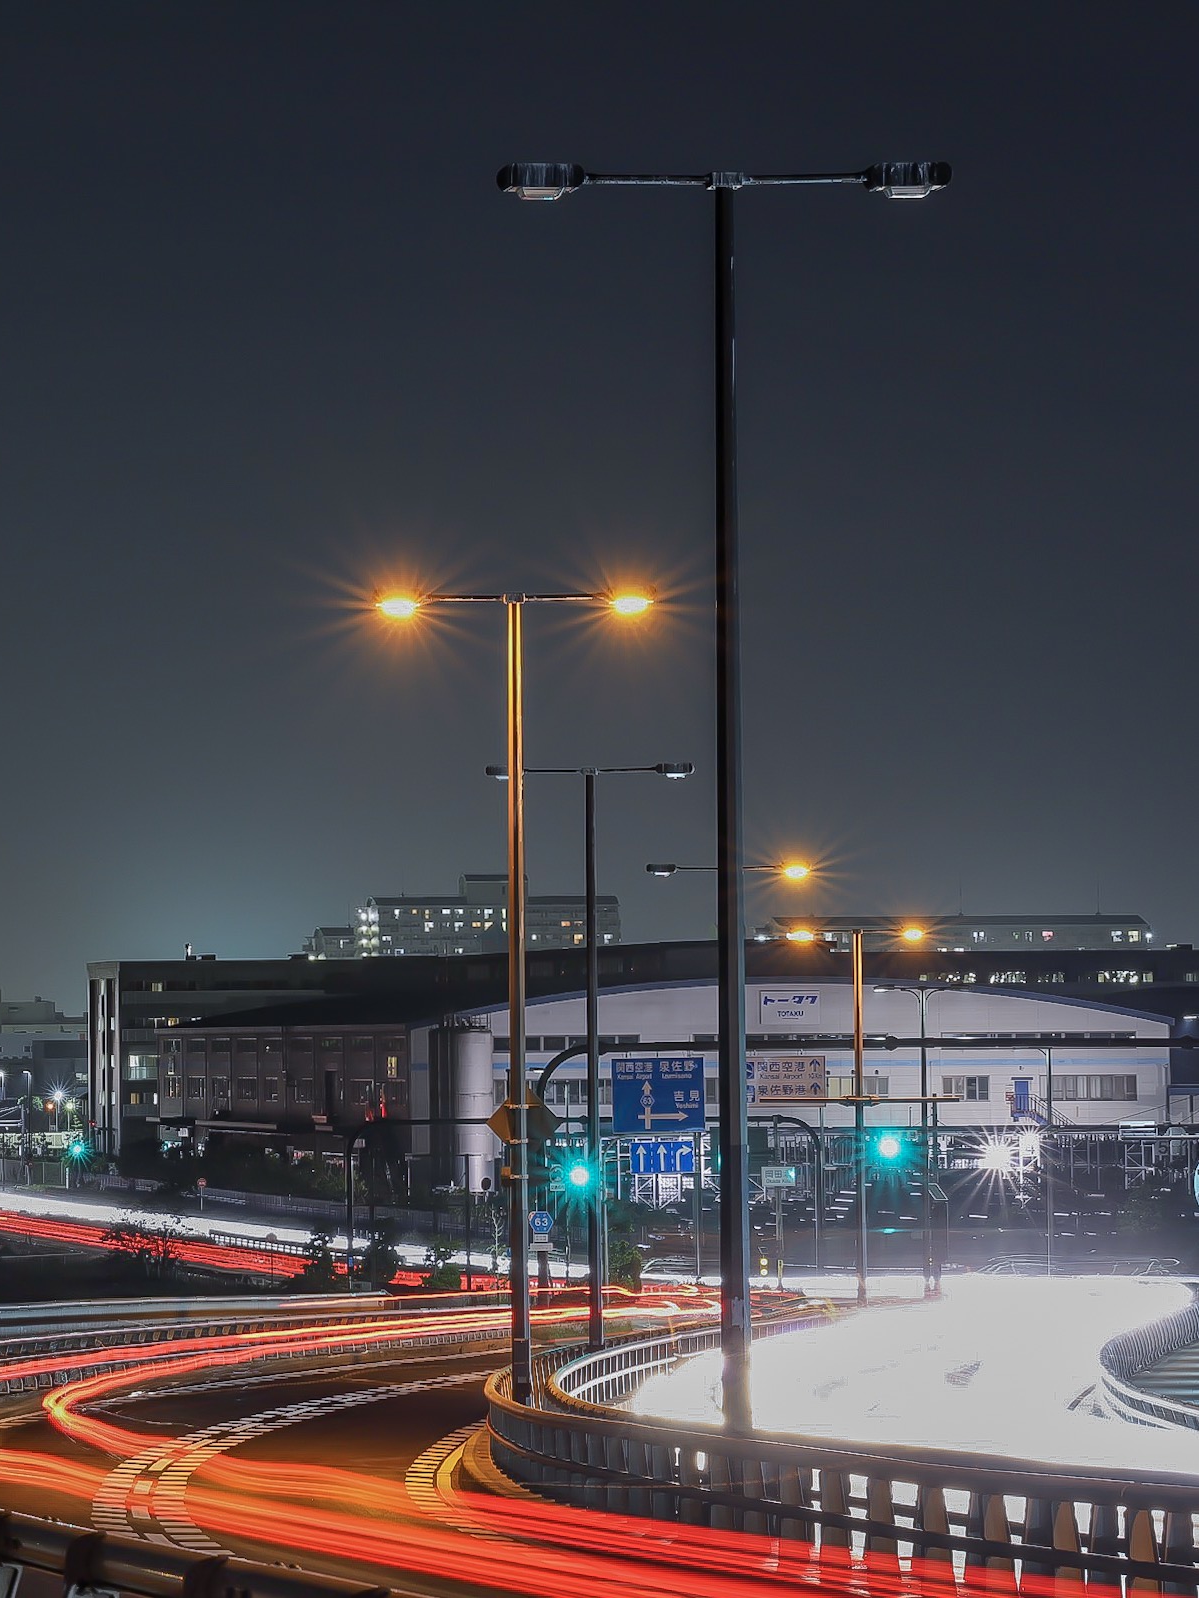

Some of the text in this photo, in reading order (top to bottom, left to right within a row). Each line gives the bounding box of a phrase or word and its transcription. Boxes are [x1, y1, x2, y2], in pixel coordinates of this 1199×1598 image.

[763, 995, 818, 1006] トータク
[616, 1060, 695, 1073] 関西空港 泉佐野
[757, 1061, 806, 1072] 関西空港
[673, 1090, 700, 1101] 吉見
[757, 1084, 807, 1096] 泉佐野港
[642, 1097, 652, 1105] 63
[534, 1217, 548, 1227] 63
